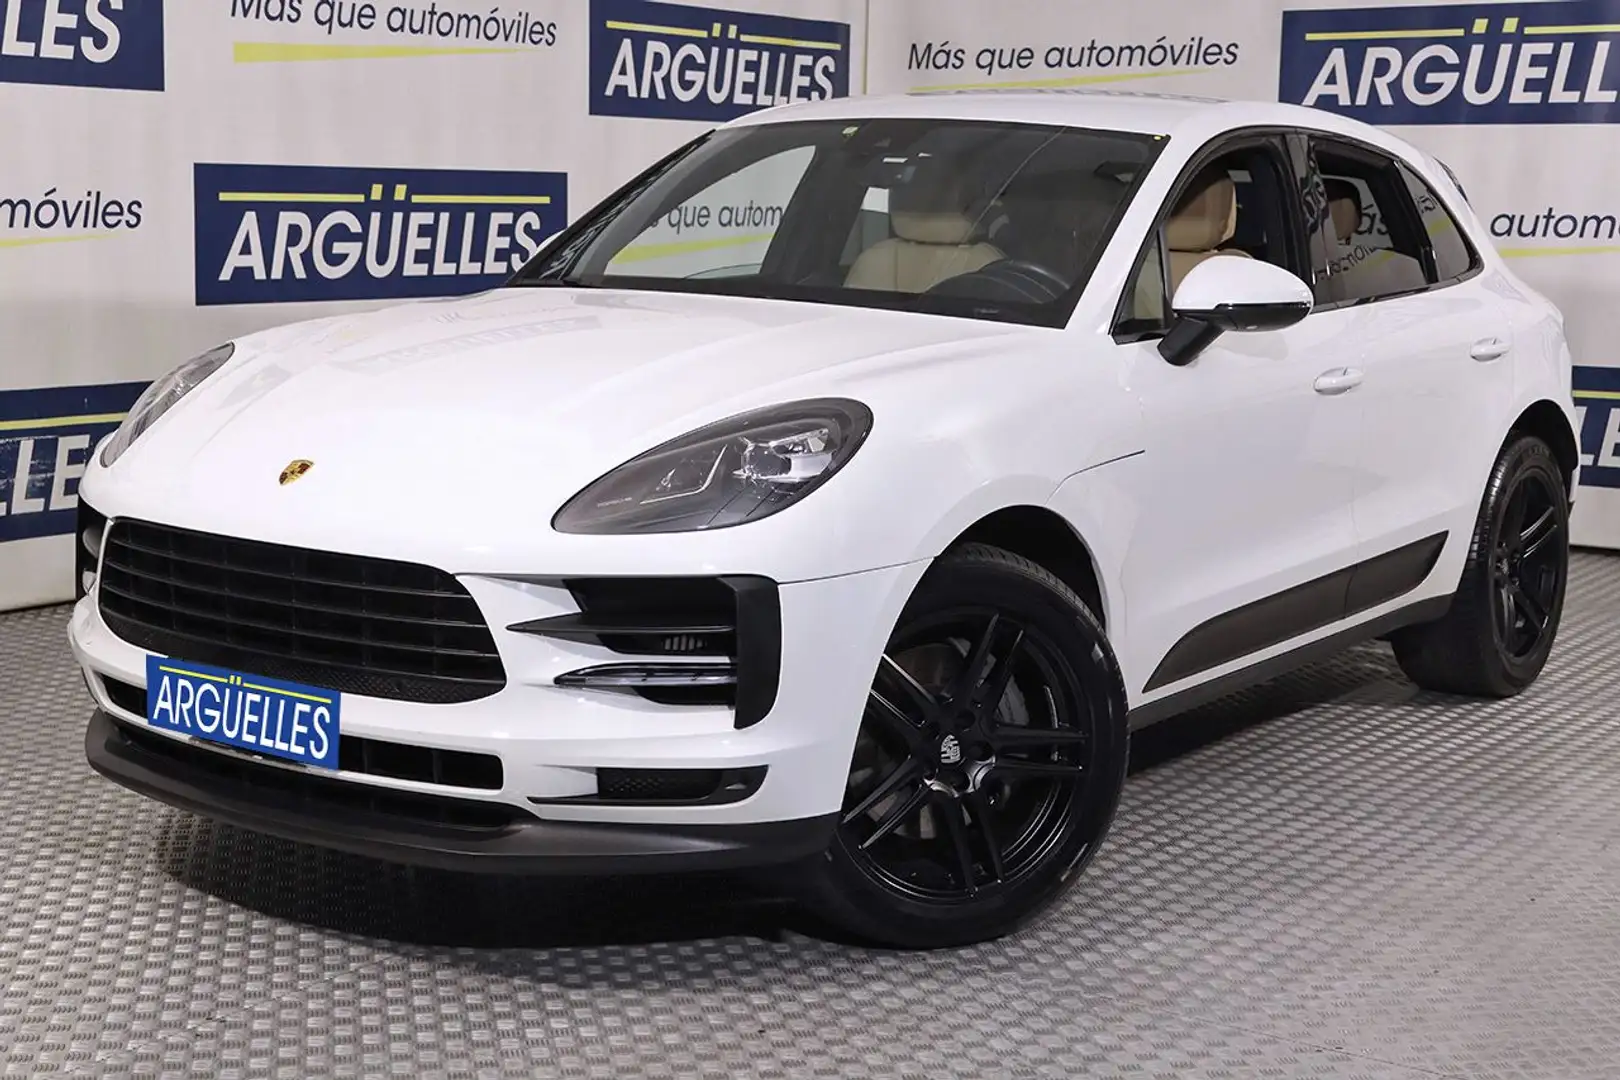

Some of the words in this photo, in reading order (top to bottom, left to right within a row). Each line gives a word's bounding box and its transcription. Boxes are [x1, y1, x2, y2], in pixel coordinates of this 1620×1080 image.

[1, 0, 124, 64] LES
[313, 0, 377, 36] que
[386, 2, 557, 47] automóviles
[907, 40, 966, 71] Más
[975, 46, 1035, 76] que
[1043, 35, 1240, 68] automóviles
[603, 22, 837, 107] ARGÜELLES
[218, 183, 541, 281] ARGÜELLES
[668, 204, 712, 235] que
[1489, 206, 1620, 239] autom
[0, 433, 91, 517] LE
[152, 675, 331, 760] ARGÜELLES
